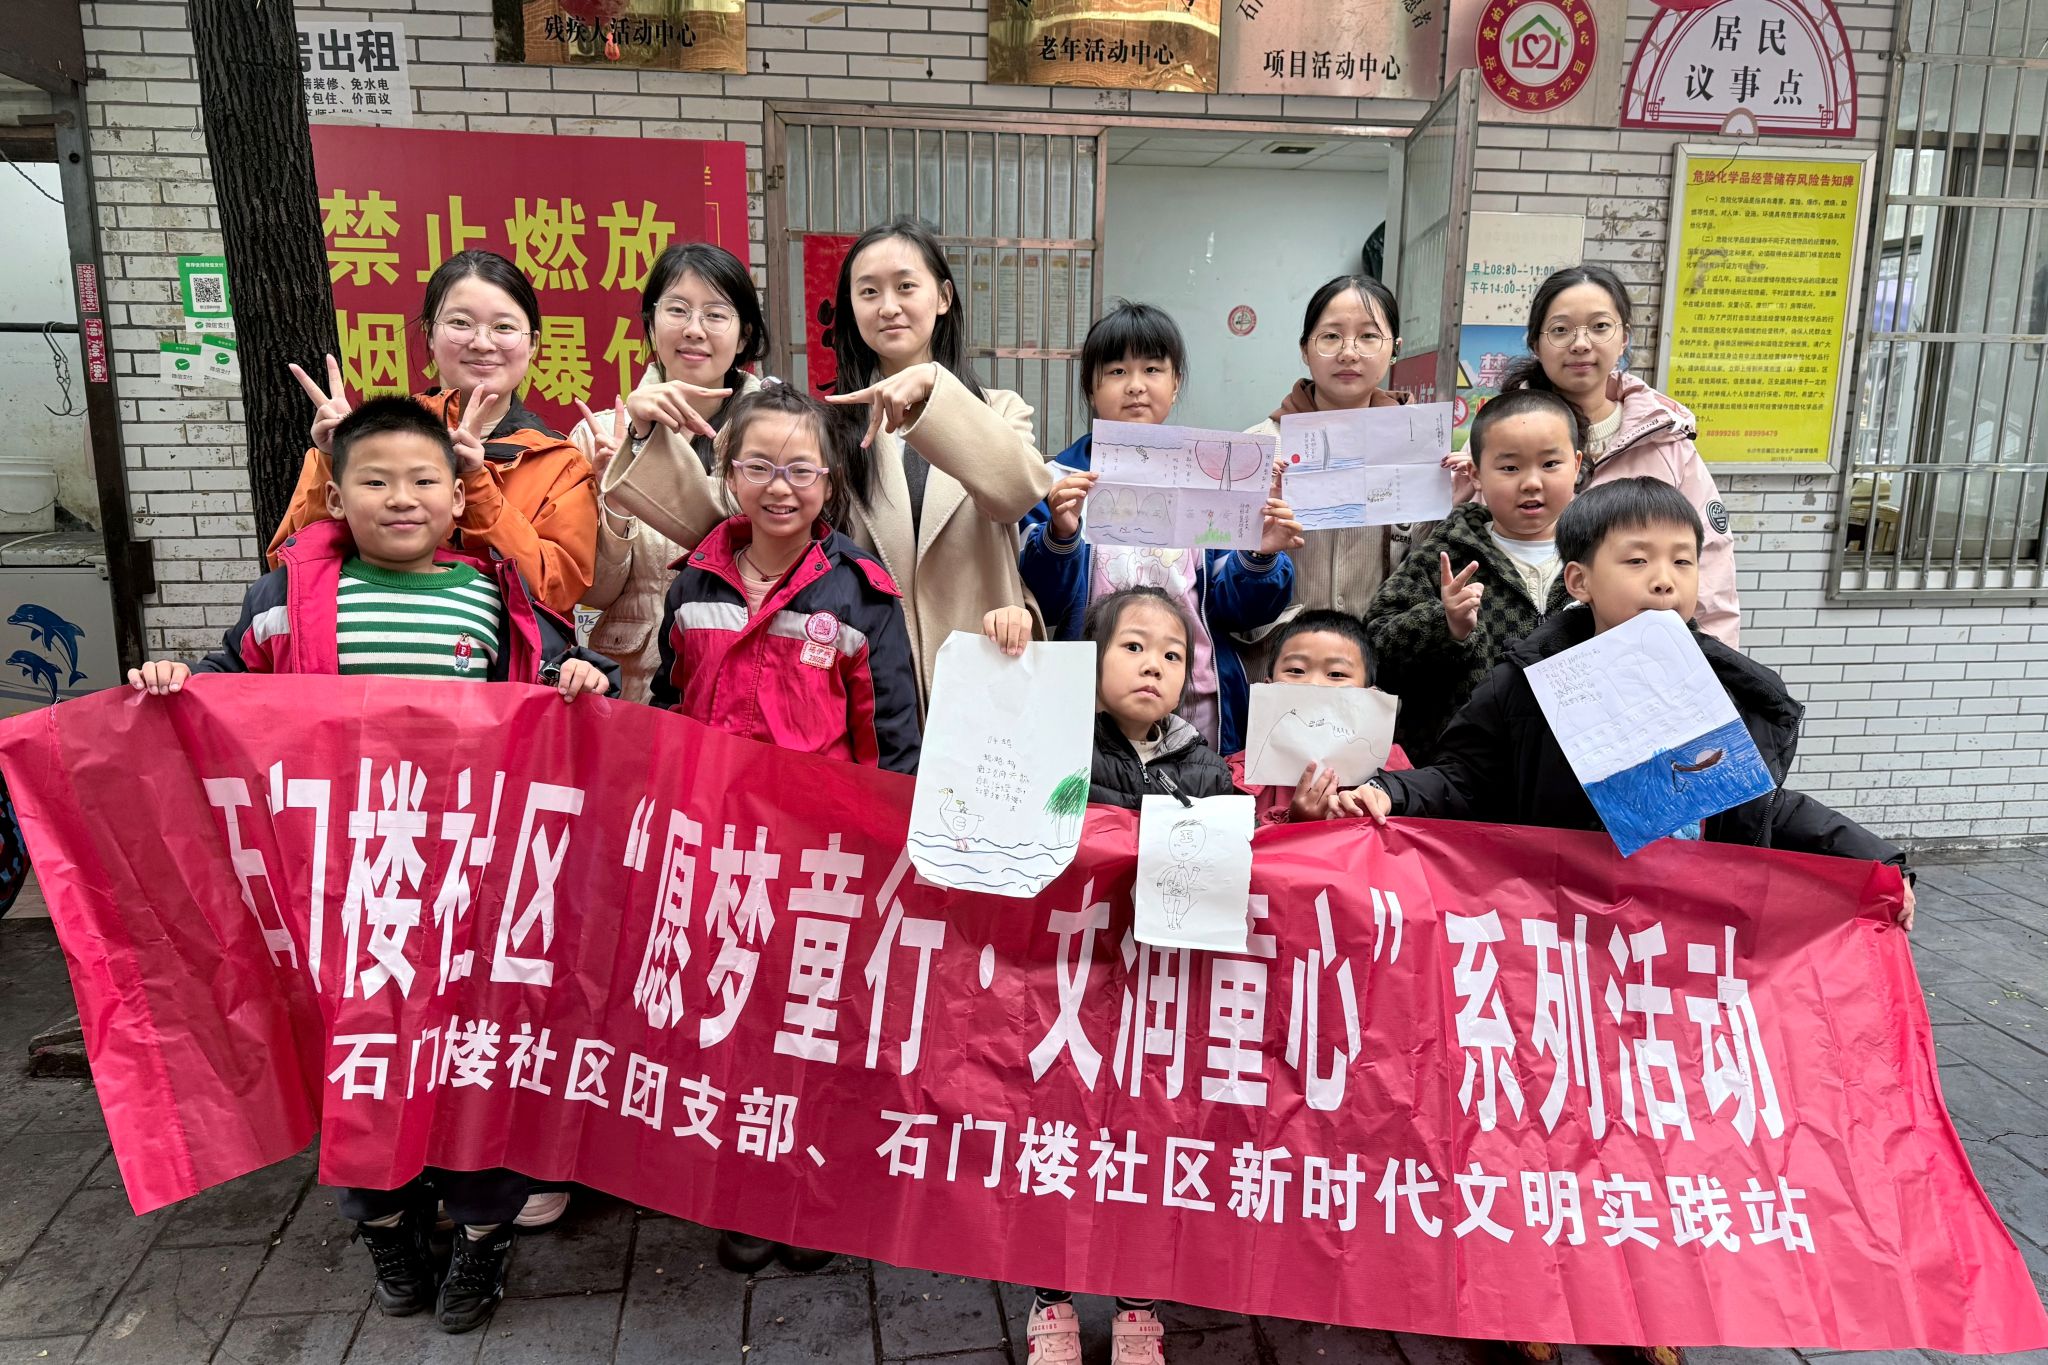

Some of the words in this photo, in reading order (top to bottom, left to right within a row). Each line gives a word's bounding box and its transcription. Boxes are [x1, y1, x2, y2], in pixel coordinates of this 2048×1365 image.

[543, 15, 697, 48] 残疾人活动中心
[1711, 15, 1787, 55] 居民
[1037, 36, 1174, 65] 老年活动中心
[1263, 49, 1401, 81] 项目活动中心
[1684, 64, 1804, 105] 议事点
[1693, 170, 1855, 188] 危险化学品经营储存风险告知牌
[318, 188, 676, 292] 禁止燃放
[203, 757, 585, 1001] 石门楼社区
[1444, 908, 1785, 1147] 系列活动
